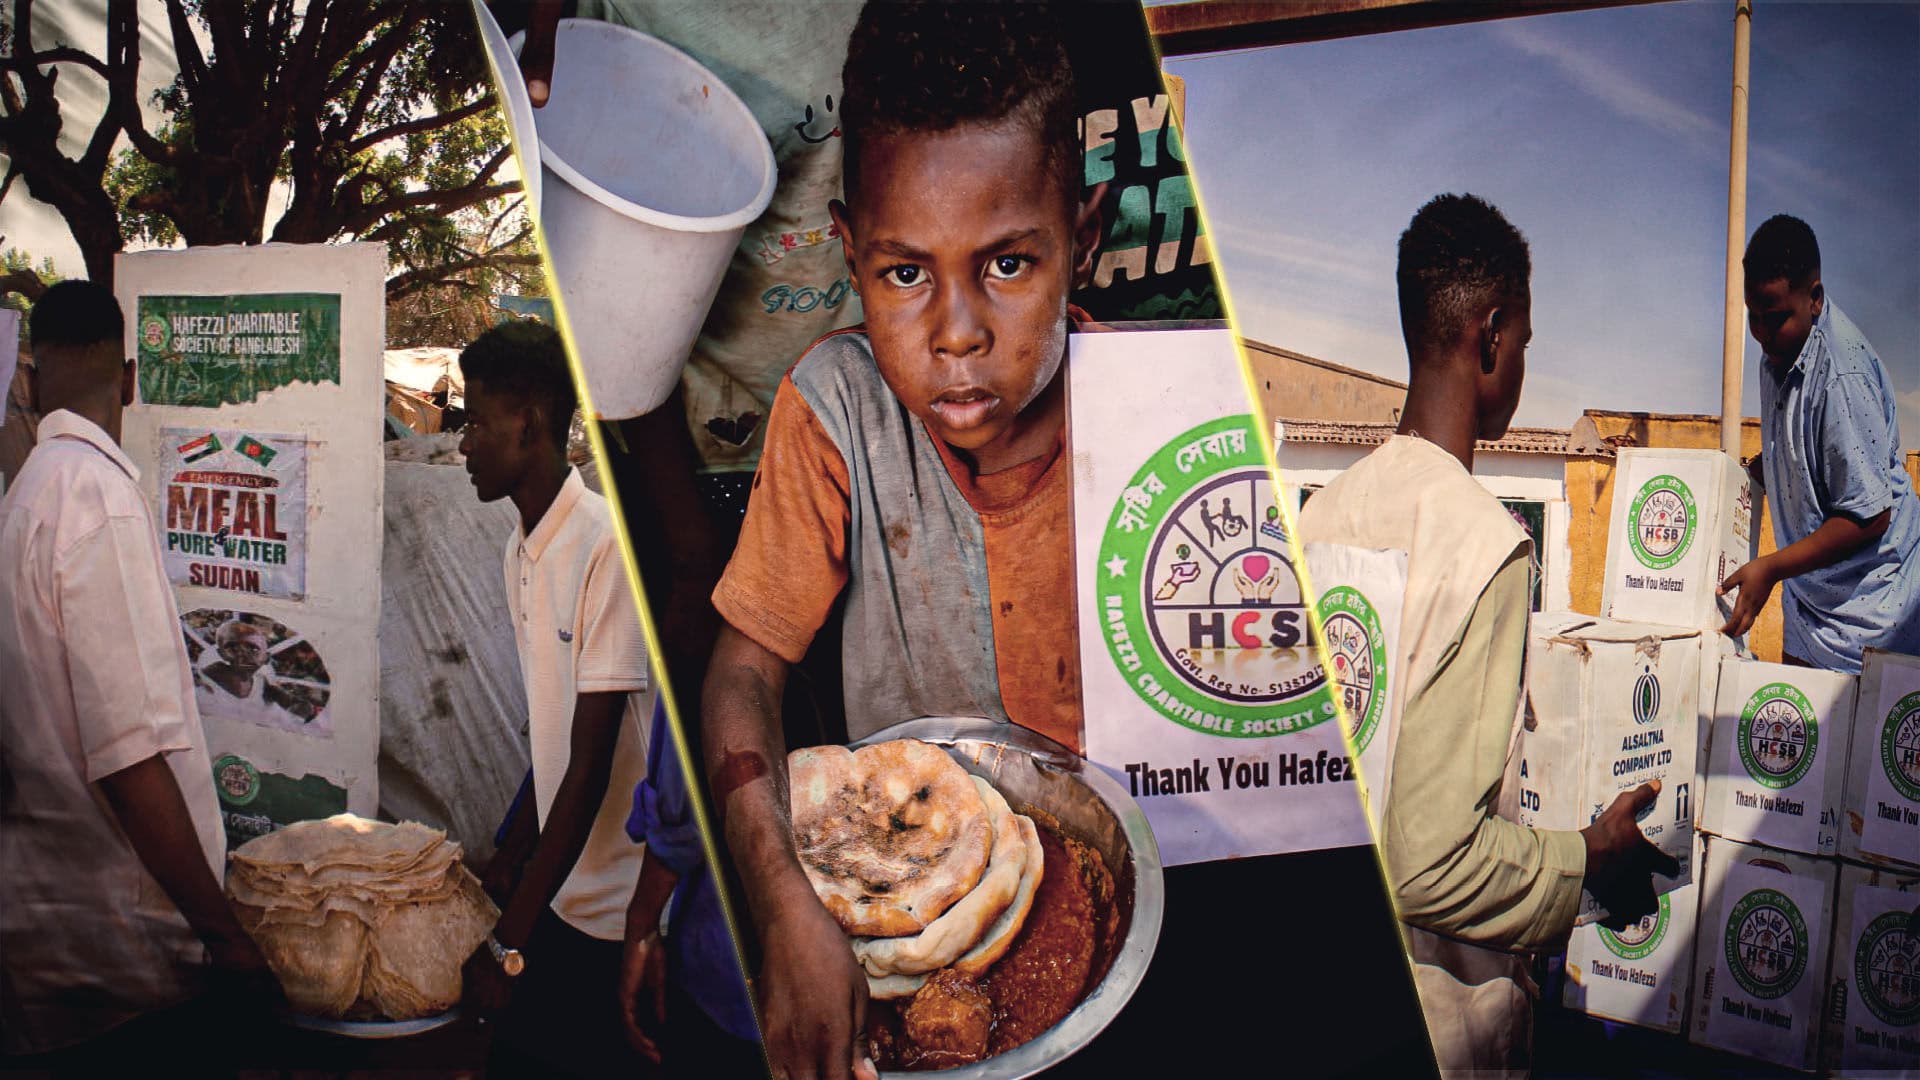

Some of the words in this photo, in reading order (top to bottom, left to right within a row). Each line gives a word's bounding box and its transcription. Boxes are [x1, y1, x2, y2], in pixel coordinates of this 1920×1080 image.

[1077, 109, 1119, 187] E
[172, 316, 225, 335] HAFEZZI
[228, 312, 301, 334] CHARITABLE
[173, 337, 216, 354] SOCIETY
[219, 338, 233, 354] OF
[234, 336, 301, 355] BANGLADESH
[1175, 428, 1248, 474] সেবায়
[190, 472, 262, 488] EMERGENCY
[214, 525, 230, 546] &
[1645, 527, 1679, 541] HCSB
[168, 532, 215, 557] PURE
[223, 538, 287, 565] WATER
[190, 562, 260, 594] SUDAN
[1625, 574, 1645, 589] Thank
[1646, 576, 1658, 590] You
[1659, 577, 1684, 593] Hafezzi
[1105, 595, 1142, 673] HAFEZZI
[1138, 673, 1234, 733] CHARITABLE
[1241, 709, 1314, 734] SOCIETY
[1622, 729, 1664, 752] ALSALTNA
[1757, 738, 1798, 758] HCSB
[1613, 752, 1657, 777] COMPANY
[1657, 749, 1673, 767] LTD
[1125, 758, 1210, 797] Thank
[1217, 756, 1270, 790] You
[1520, 788, 1541, 812] LTD
[1735, 790, 1758, 809] Thank
[1759, 791, 1774, 811] You
[1775, 795, 1804, 817] Hafezzi
[1877, 801, 1903, 822] Thank
[1903, 806, 1919, 826] You
[1591, 959, 1613, 979] Thank
[1614, 963, 1629, 981] You
[1629, 967, 1658, 988] Hafezzi
